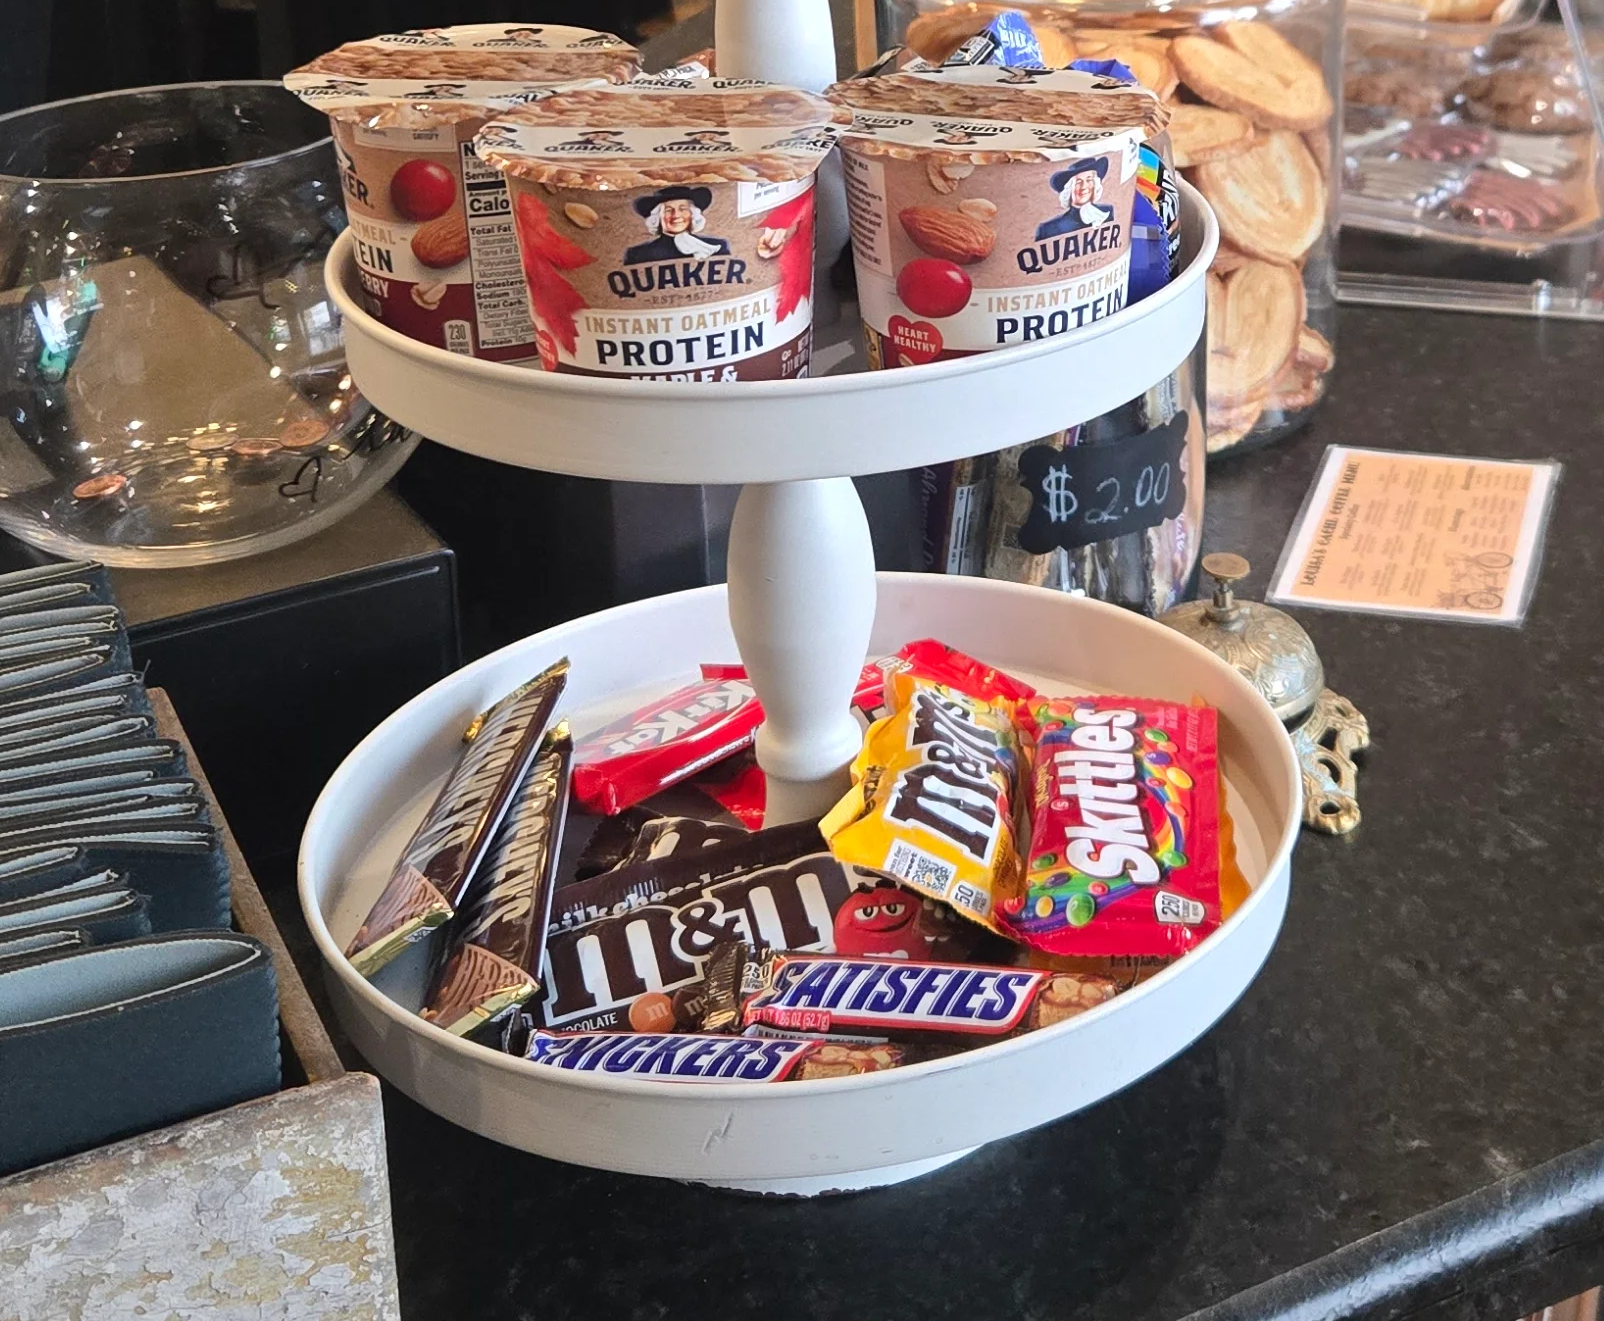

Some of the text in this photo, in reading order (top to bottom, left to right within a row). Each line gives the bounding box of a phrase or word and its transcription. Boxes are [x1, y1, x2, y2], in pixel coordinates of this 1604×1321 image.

[932, 120, 1014, 135] QUAKER
[544, 145, 632, 153] QUAKER
[652, 144, 742, 153] QUAKER
[469, 197, 510, 213] Calo
[470, 224, 512, 235] Total Fat
[1016, 224, 1122, 275] QUAKER
[475, 279, 525, 290] Cholestero
[607, 257, 747, 299] QUAKER
[986, 259, 1128, 314] INSTANT OATMEAL
[476, 291, 510, 300] Sodium
[478, 301, 500, 310] Total
[996, 284, 1123, 344] PROTEIN
[584, 297, 772, 335] INSTANT OATMEAL
[449, 323, 466, 340] 230
[897, 325, 929, 340] HEART
[481, 338, 513, 347] Protein
[595, 321, 764, 366] PROTEIN
[893, 335, 937, 354] HEALTHY
[1053, 707, 1161, 885] Skittles
[1161, 894, 1181, 917] 250
[743, 963, 770, 980] 250
[751, 961, 1034, 1021] SATISFIES
[529, 1034, 798, 1078] SNICKERS
